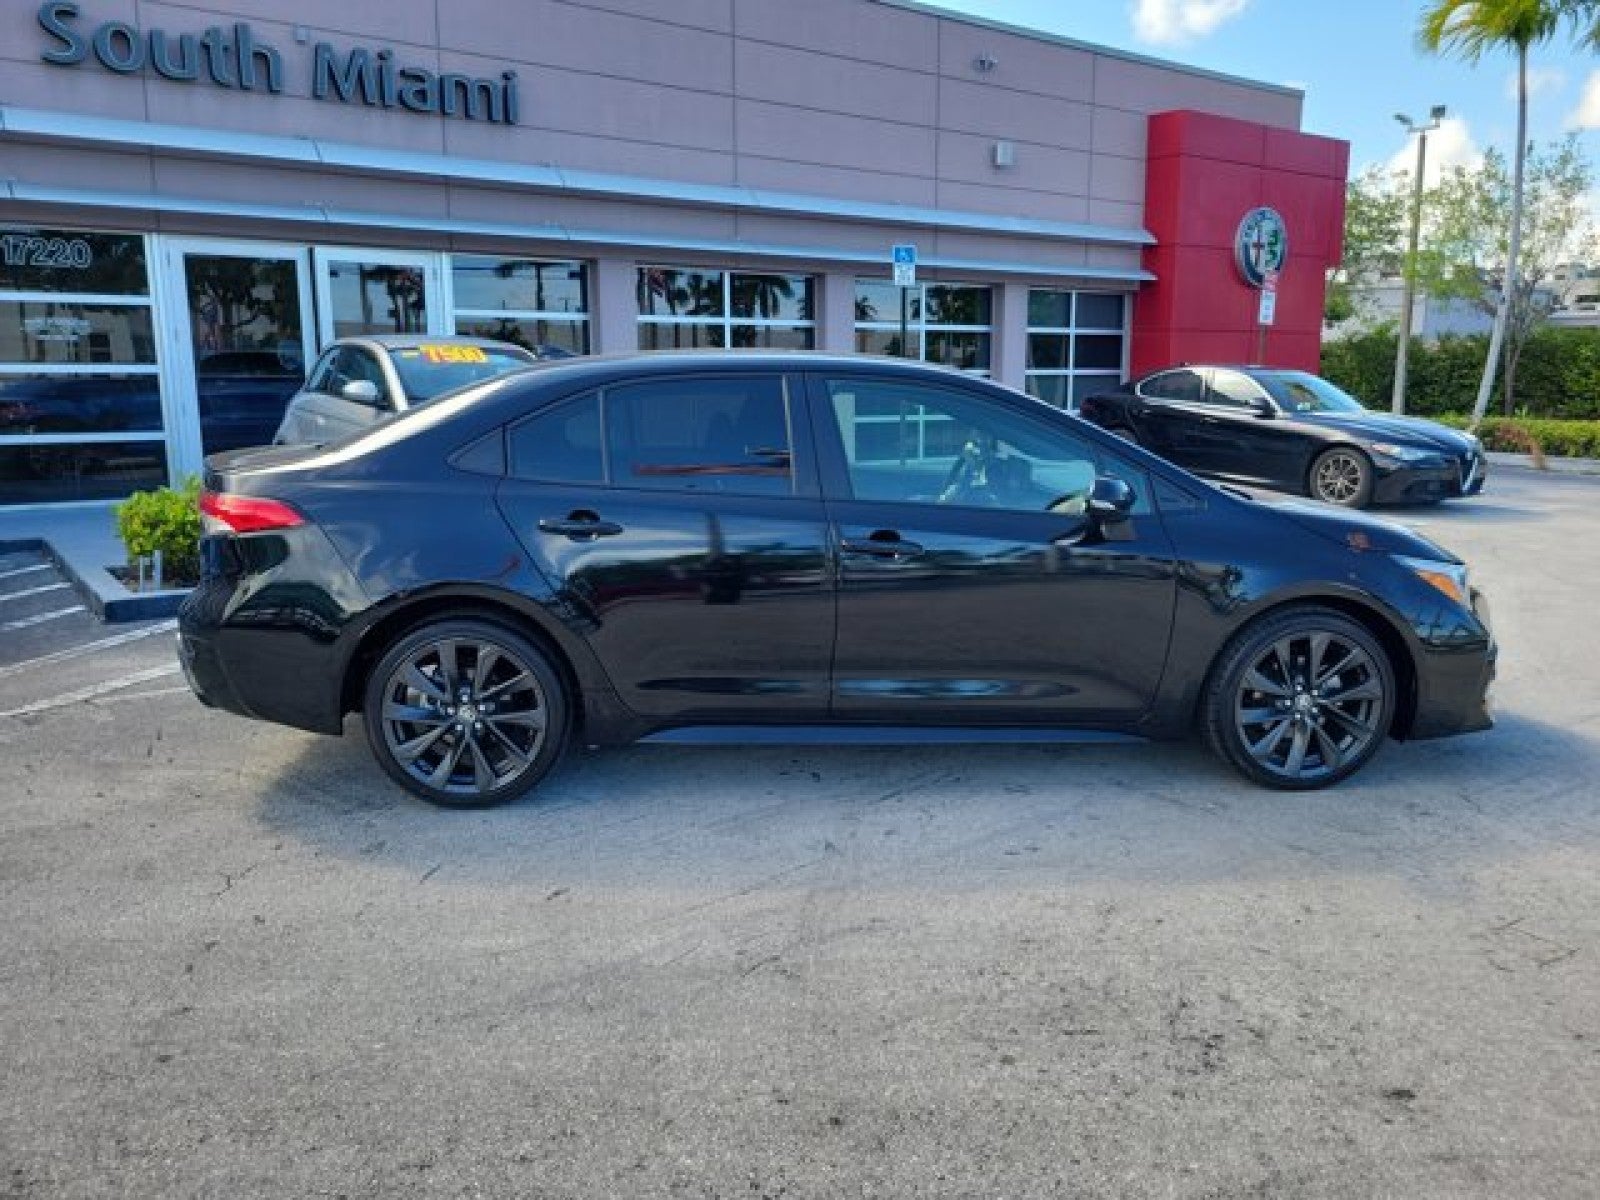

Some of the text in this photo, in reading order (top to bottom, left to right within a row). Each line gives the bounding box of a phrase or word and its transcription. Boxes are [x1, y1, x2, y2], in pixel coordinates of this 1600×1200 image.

[38, 1, 520, 125] South Miami
[2, 235, 91, 268] 17220
